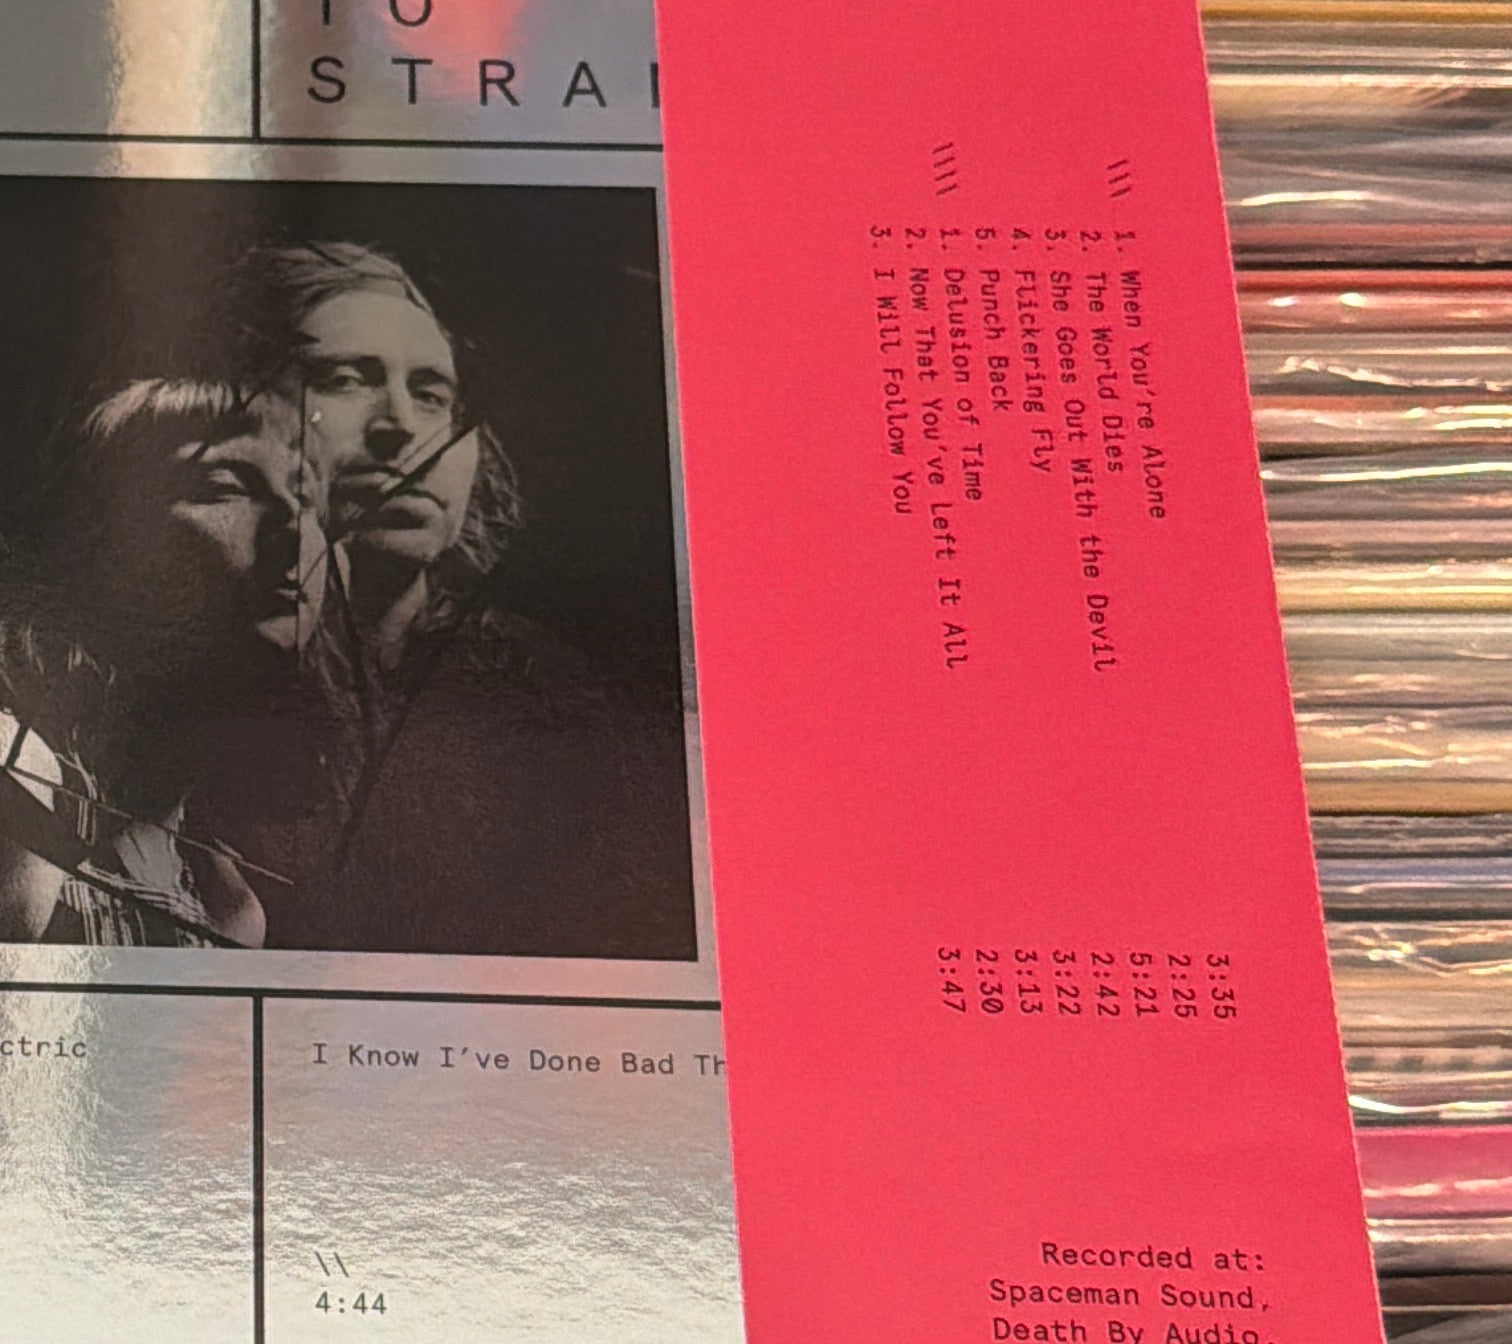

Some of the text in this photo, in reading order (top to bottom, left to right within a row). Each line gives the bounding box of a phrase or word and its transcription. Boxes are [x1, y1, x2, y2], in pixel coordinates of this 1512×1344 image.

[307, 56, 661, 109] STRA
[940, 228, 960, 250] 1.
[944, 269, 972, 384] Delusion
[975, 228, 1014, 411] 5. Punch Back
[1011, 228, 1054, 472] 4. Flickering Fly
[1079, 231, 1123, 473] 2. The World Dies
[870, 226, 914, 514] 3. I Will Follow You
[1114, 231, 1167, 519] 1. When You're Alone
[905, 227, 969, 669] 2. Now That You've Left It All
[962, 443, 984, 501] Time
[1045, 228, 1116, 672] 3. She Goes Out With the Devil
[938, 947, 967, 1013] 3:47
[975, 949, 1004, 1014] 2:30
[1015, 949, 1043, 1014] 3:13
[1053, 950, 1082, 1016] 3:22
[1090, 952, 1121, 1017] 2:42
[1130, 952, 1160, 1017] 5:21
[1168, 954, 1198, 1018] 2:25
[1207, 954, 1237, 1019] 3:35
[313, 1043, 327, 1064] I
[349, 1044, 419, 1067] Know
[440, 1046, 510, 1069] I've
[529, 1050, 600, 1072] Done
[622, 1052, 674, 1075] Bad
[1041, 1242, 1264, 1270] Recorded at:
[315, 1292, 387, 1315] 4:44
[989, 1279, 1270, 1312] Spaceman Sound,
[993, 1318, 1086, 1343] Death
